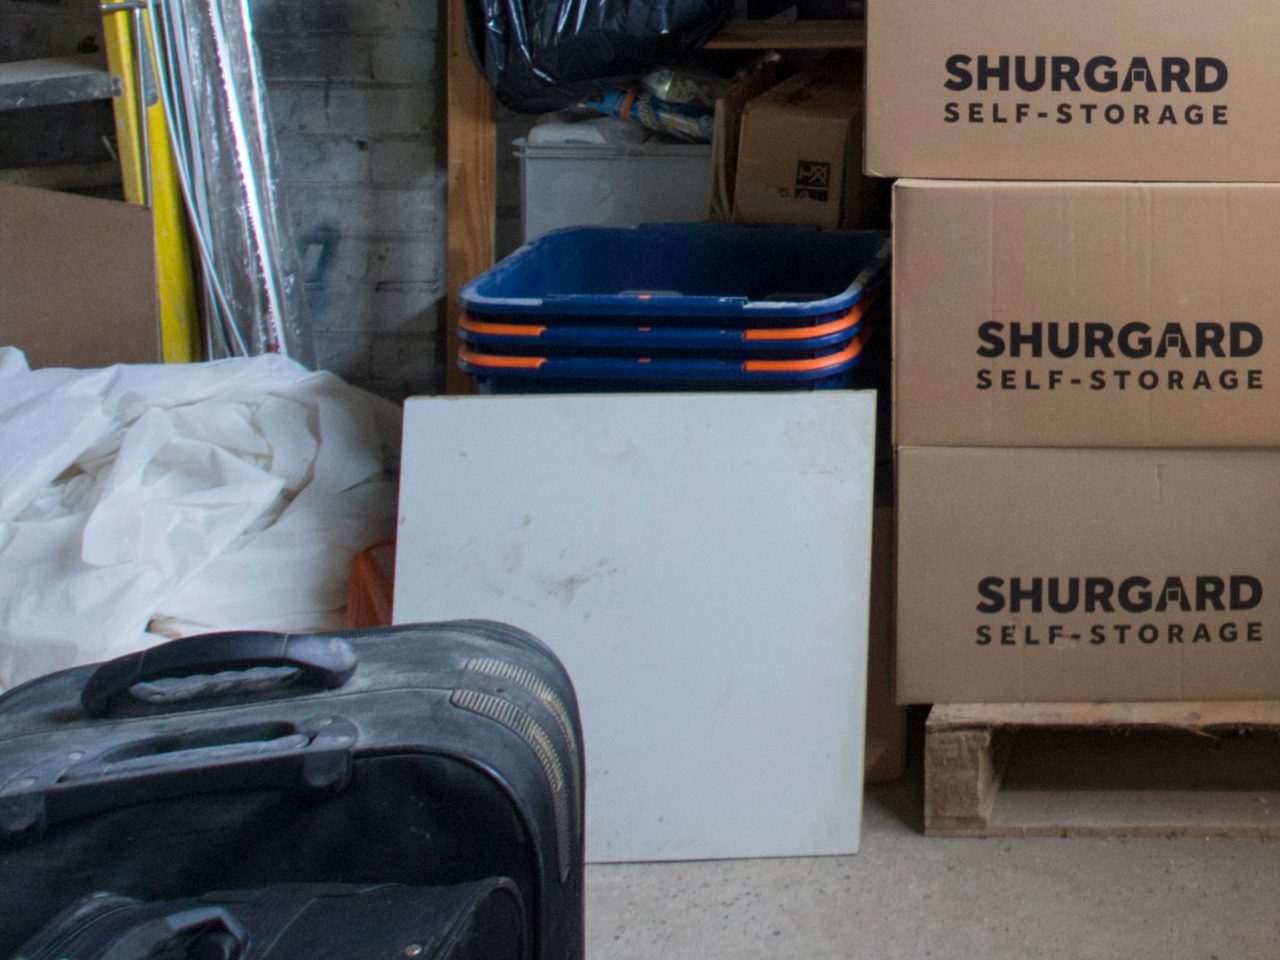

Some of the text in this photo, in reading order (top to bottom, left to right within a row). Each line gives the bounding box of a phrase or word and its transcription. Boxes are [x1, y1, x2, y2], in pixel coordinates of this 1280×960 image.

[943, 53, 1228, 93] SHURGARD
[943, 102, 1228, 126] SELF-STORAGE
[975, 320, 1263, 359] SHURGARD
[976, 369, 1263, 391] SELF-STORAGE
[975, 574, 1263, 614] SHURGARD
[975, 621, 1263, 646] SELF-STORAGE
